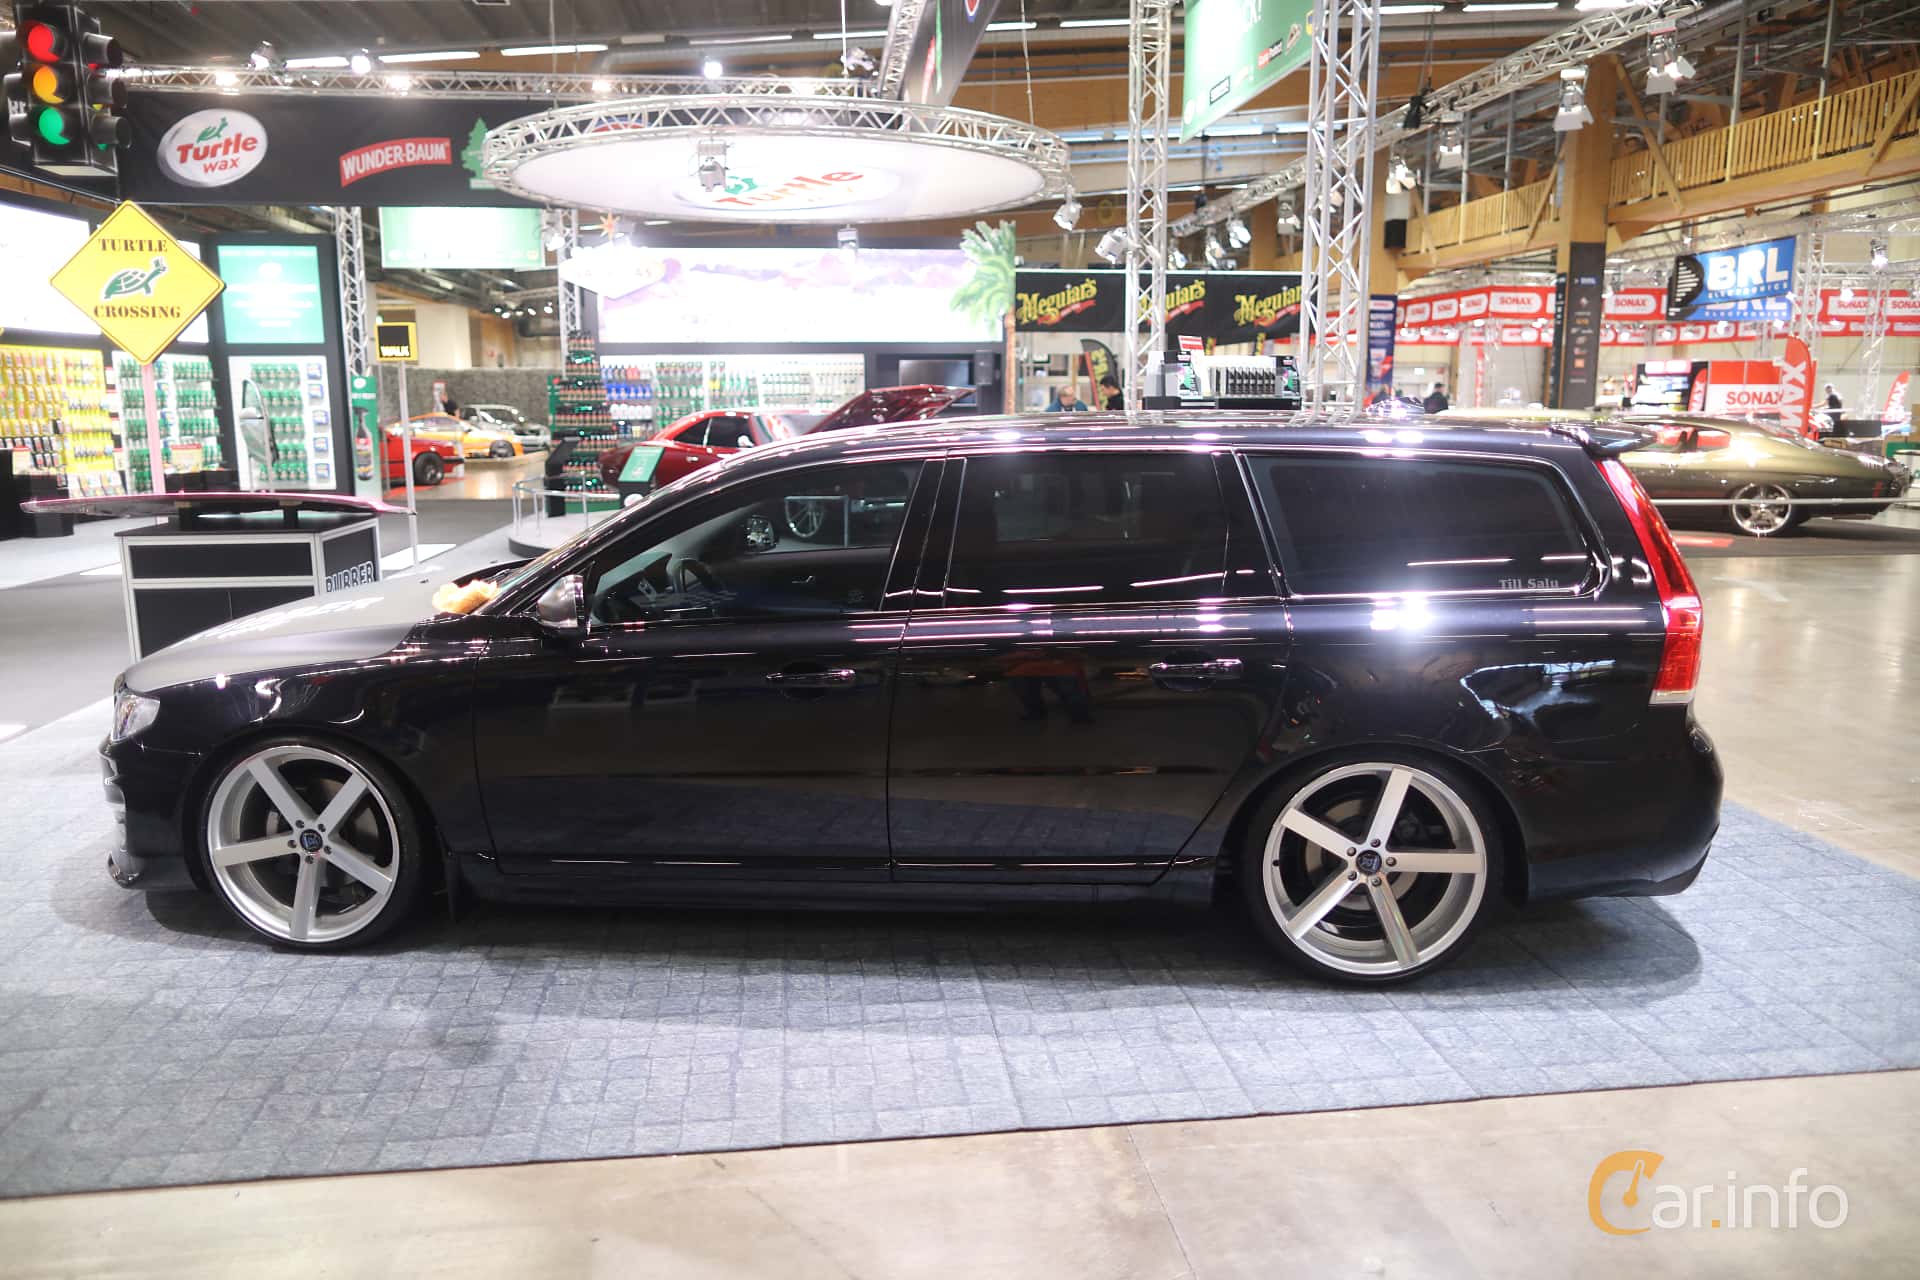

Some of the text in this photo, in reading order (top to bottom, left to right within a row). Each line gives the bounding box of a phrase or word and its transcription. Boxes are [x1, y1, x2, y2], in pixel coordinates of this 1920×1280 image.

[177, 131, 258, 164] Turtle
[203, 155, 240, 175] wax
[98, 238, 168, 253] TURTLE
[1707, 247, 1789, 291] BRL
[1016, 277, 1097, 325] Meguiar's
[93, 305, 180, 319] CROSSING
[1499, 578, 1559, 590] Till Salu
